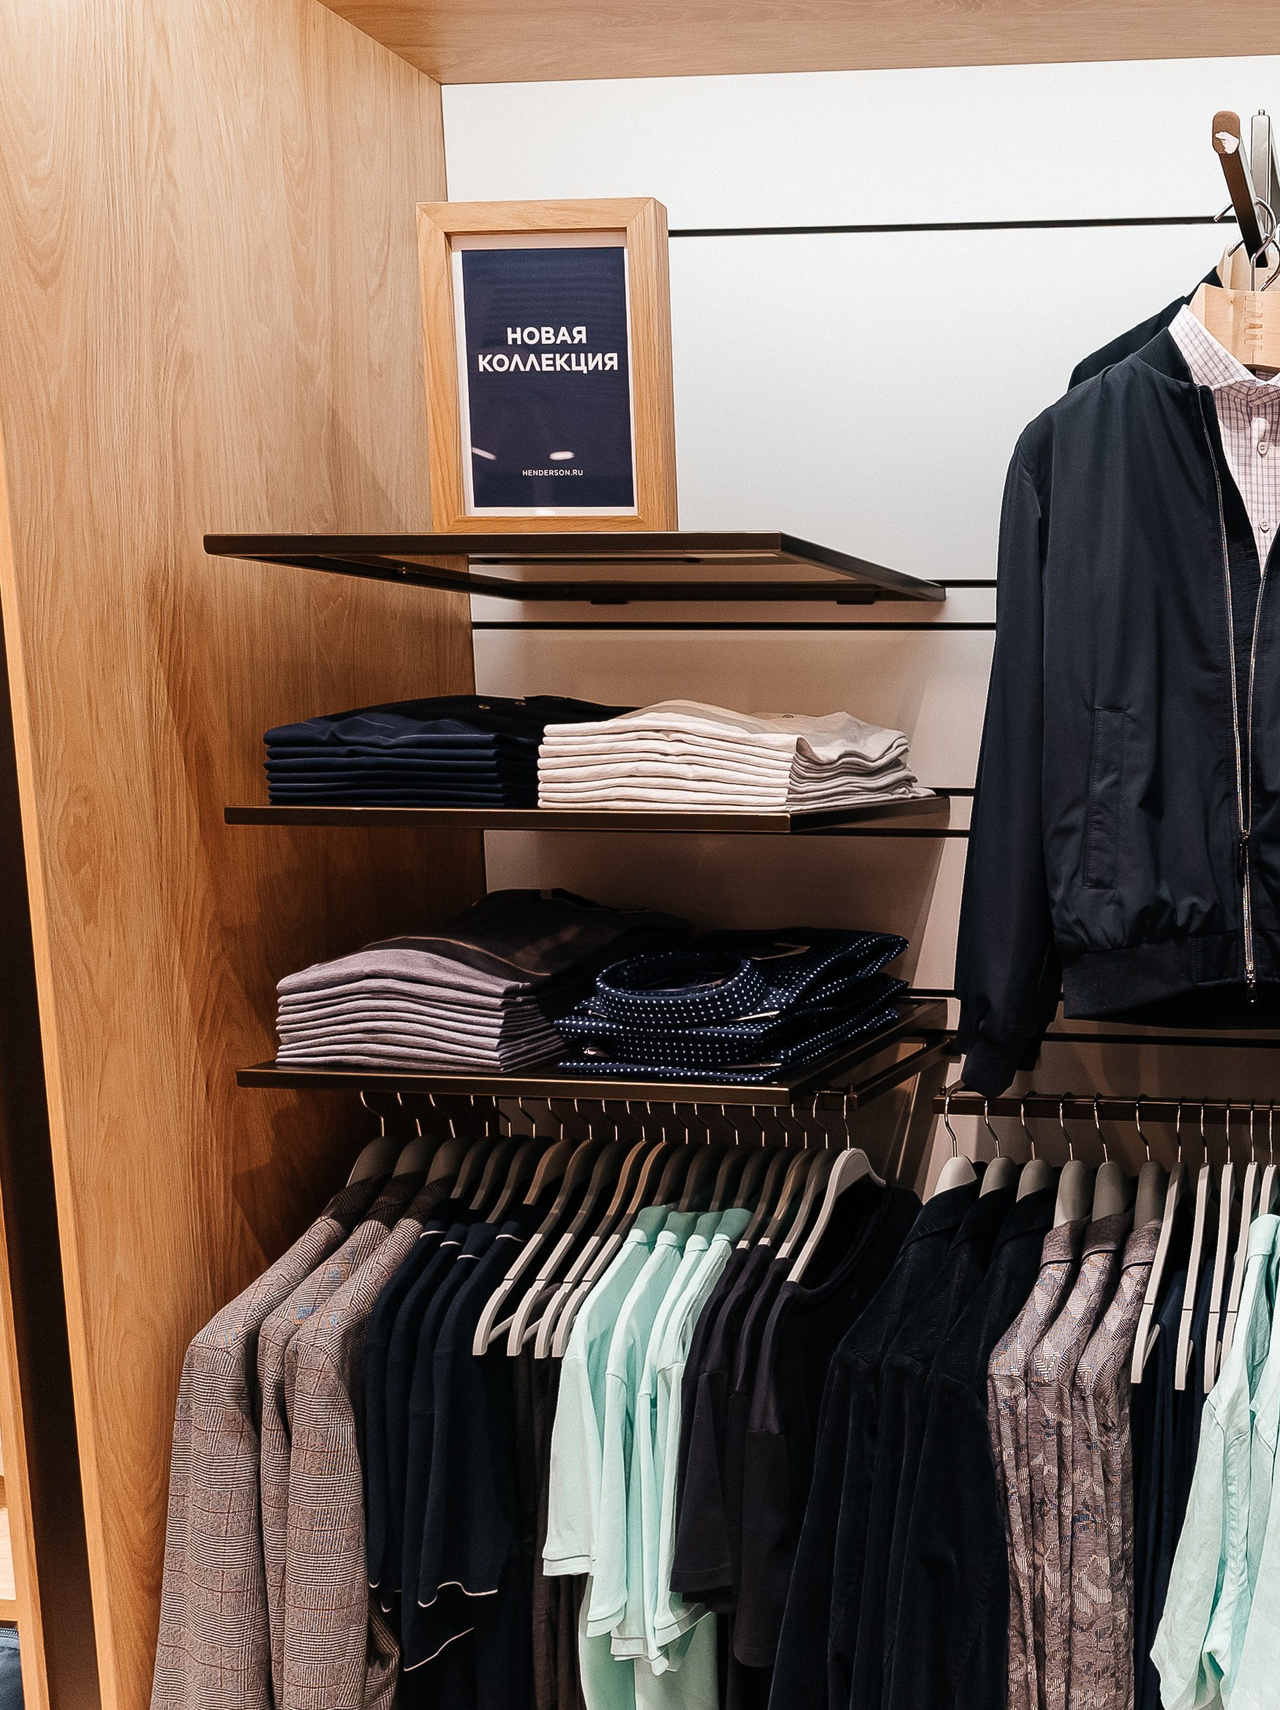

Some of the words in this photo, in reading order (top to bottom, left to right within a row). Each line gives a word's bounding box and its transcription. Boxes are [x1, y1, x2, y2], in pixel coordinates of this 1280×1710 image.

[506, 326, 588, 345] НОВАЯ
[478, 352, 619, 374] КОЛЛЕКЦИЯ
[522, 469, 584, 477] HENDERSON.RU
